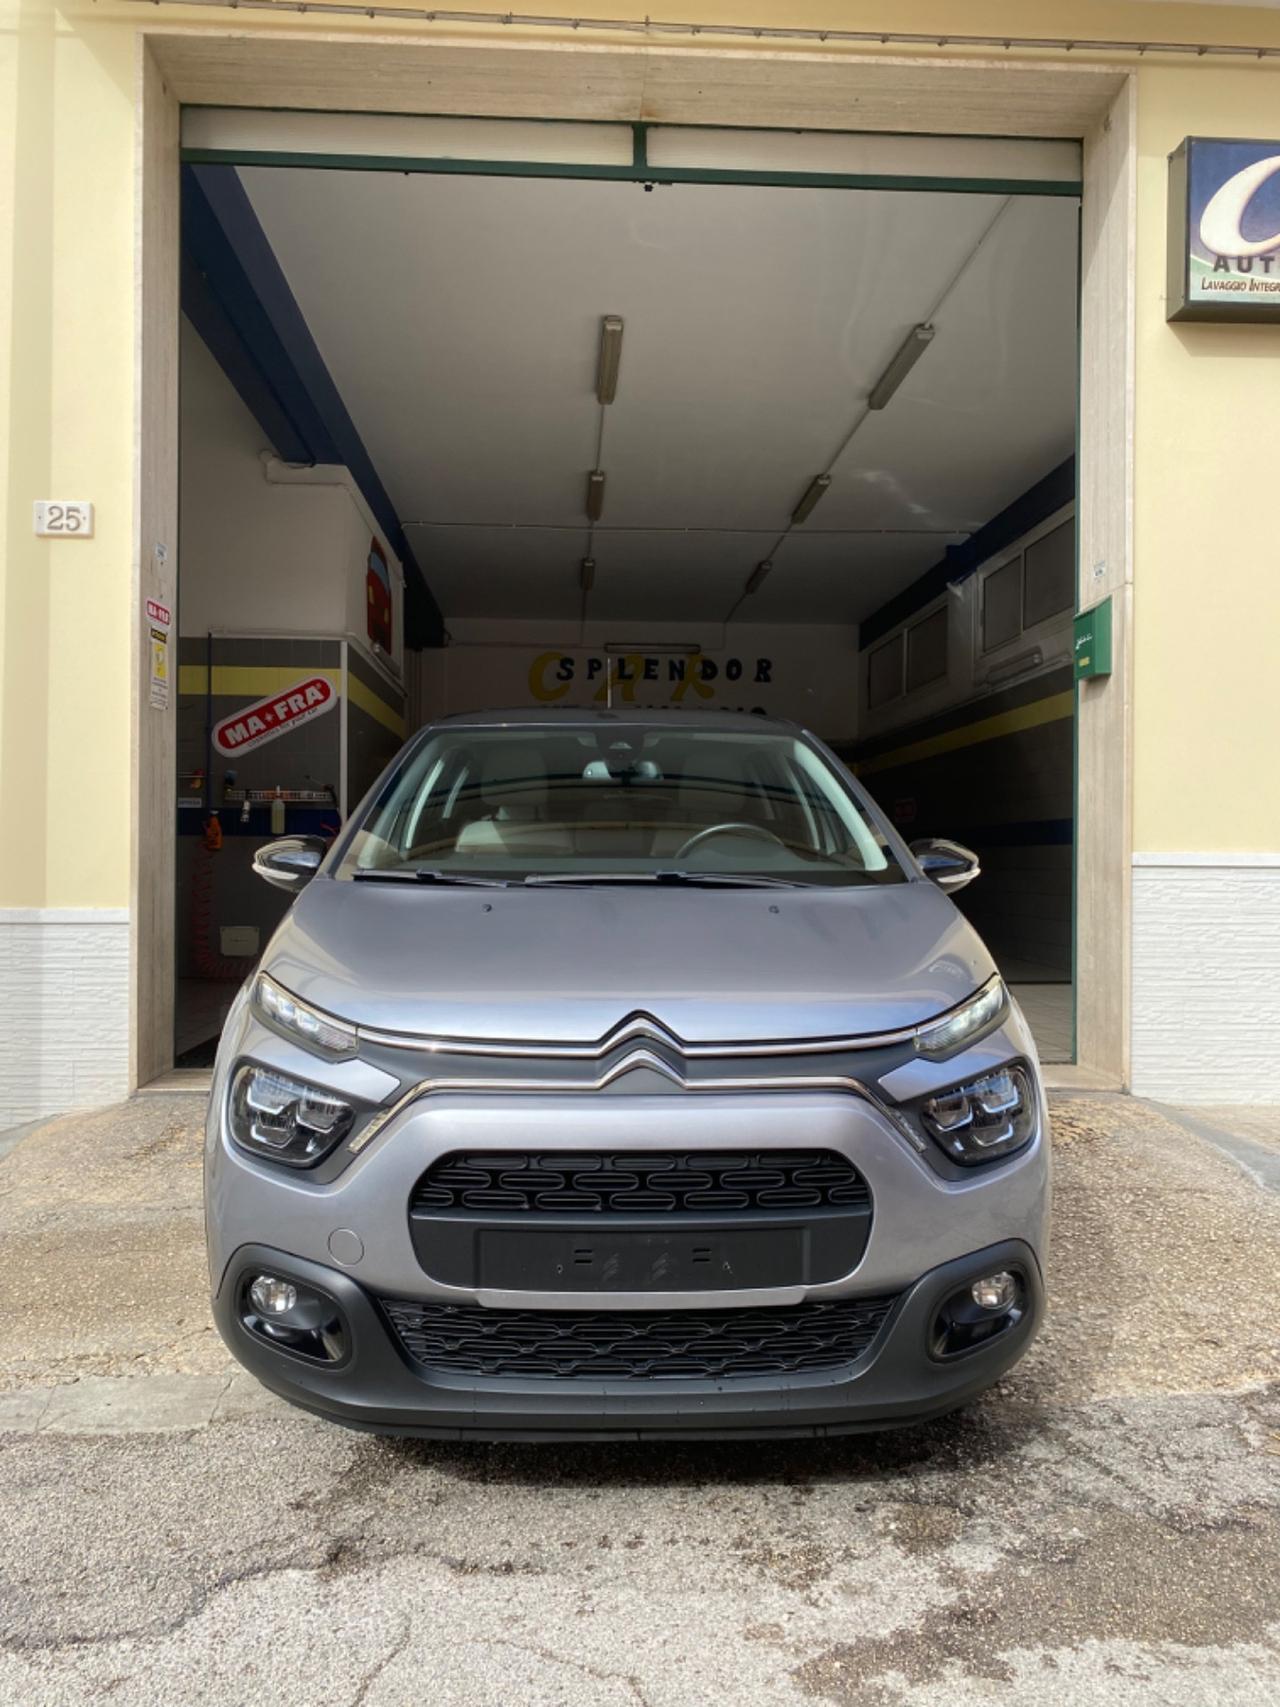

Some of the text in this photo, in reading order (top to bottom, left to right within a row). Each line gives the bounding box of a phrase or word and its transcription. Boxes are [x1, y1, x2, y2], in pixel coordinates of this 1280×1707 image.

[47, 505, 81, 531] 25
[528, 651, 715, 701] CAR
[556, 657, 772, 682] SPLENDOR
